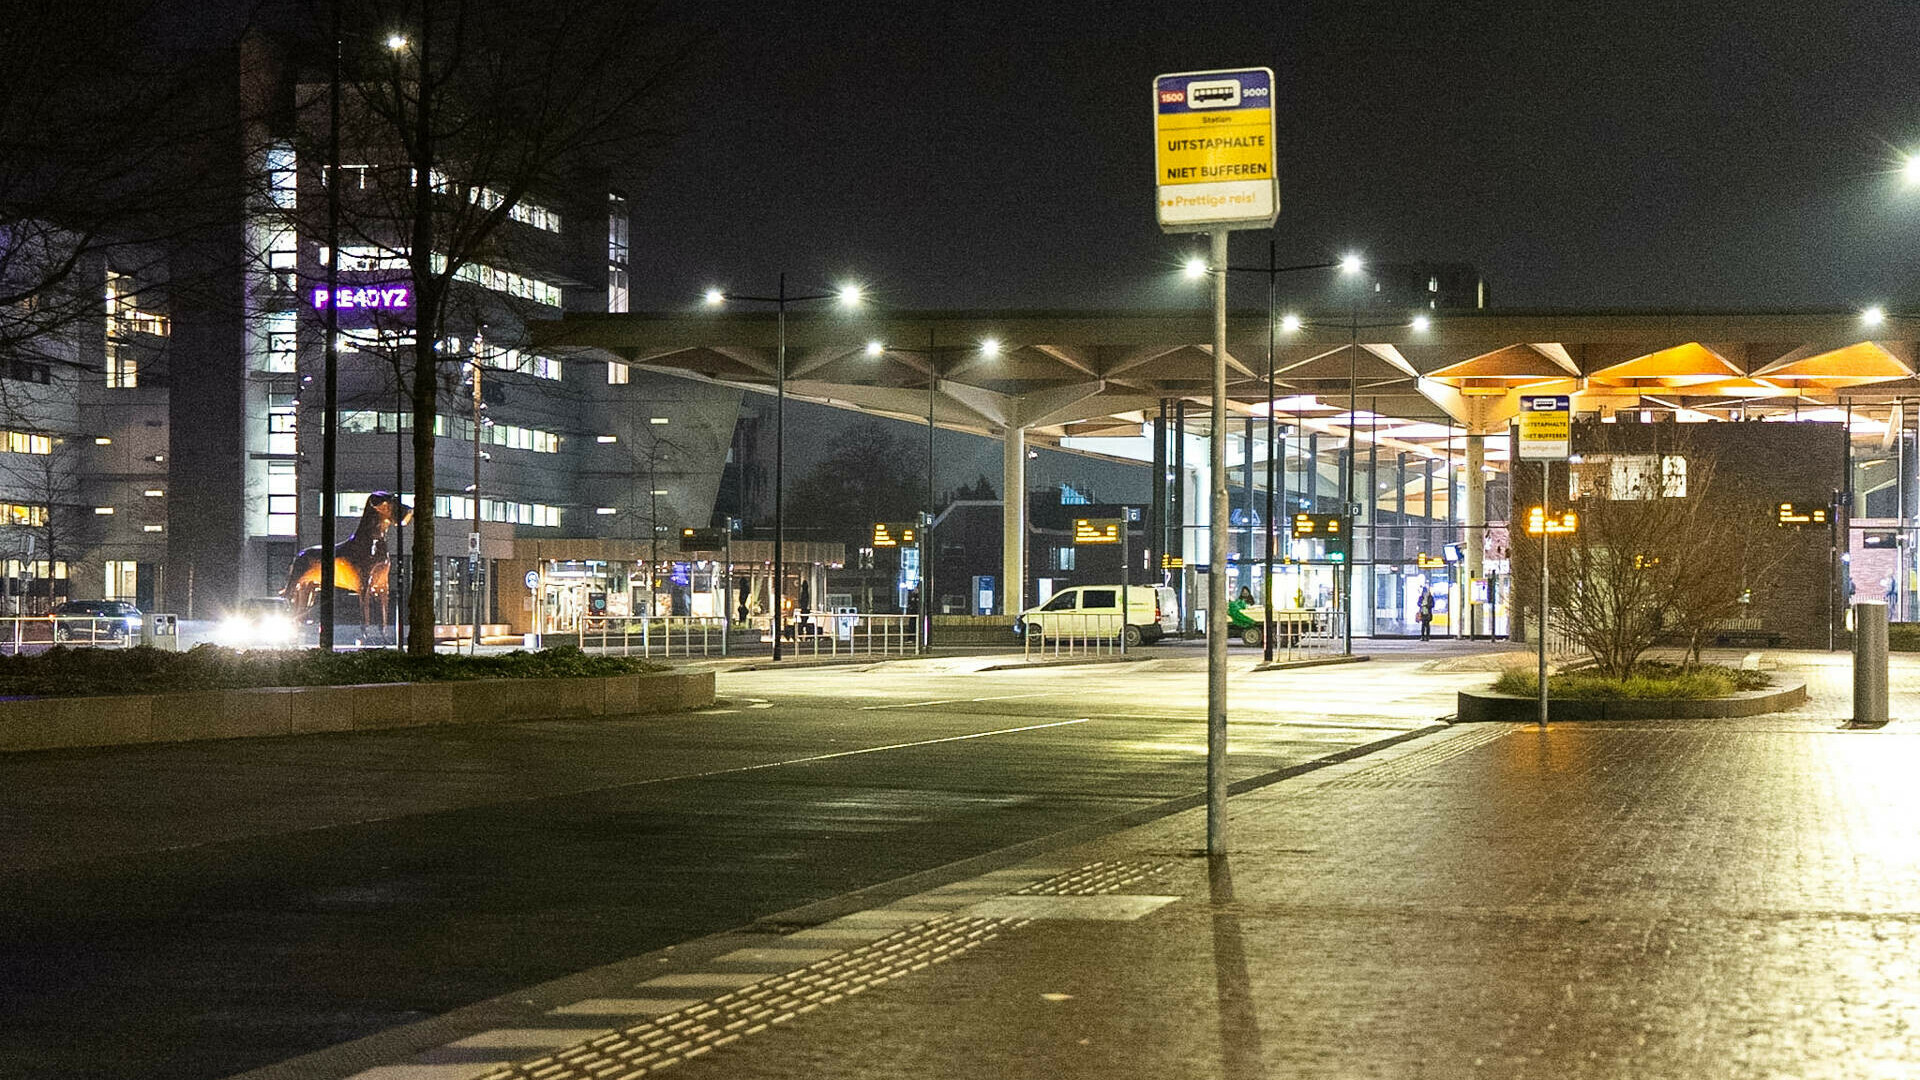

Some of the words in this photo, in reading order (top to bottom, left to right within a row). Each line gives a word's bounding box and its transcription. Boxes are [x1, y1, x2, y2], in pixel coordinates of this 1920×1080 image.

[1161, 92, 1185, 103] 1500
[1243, 87, 1268, 98] 9000
[1202, 116, 1232, 124] Station
[1168, 135, 1265, 151] UITSTAPHALTE
[1167, 167, 1197, 179] NIET
[1201, 163, 1267, 177] BUFFEREN
[1175, 193, 1226, 208] Prettige
